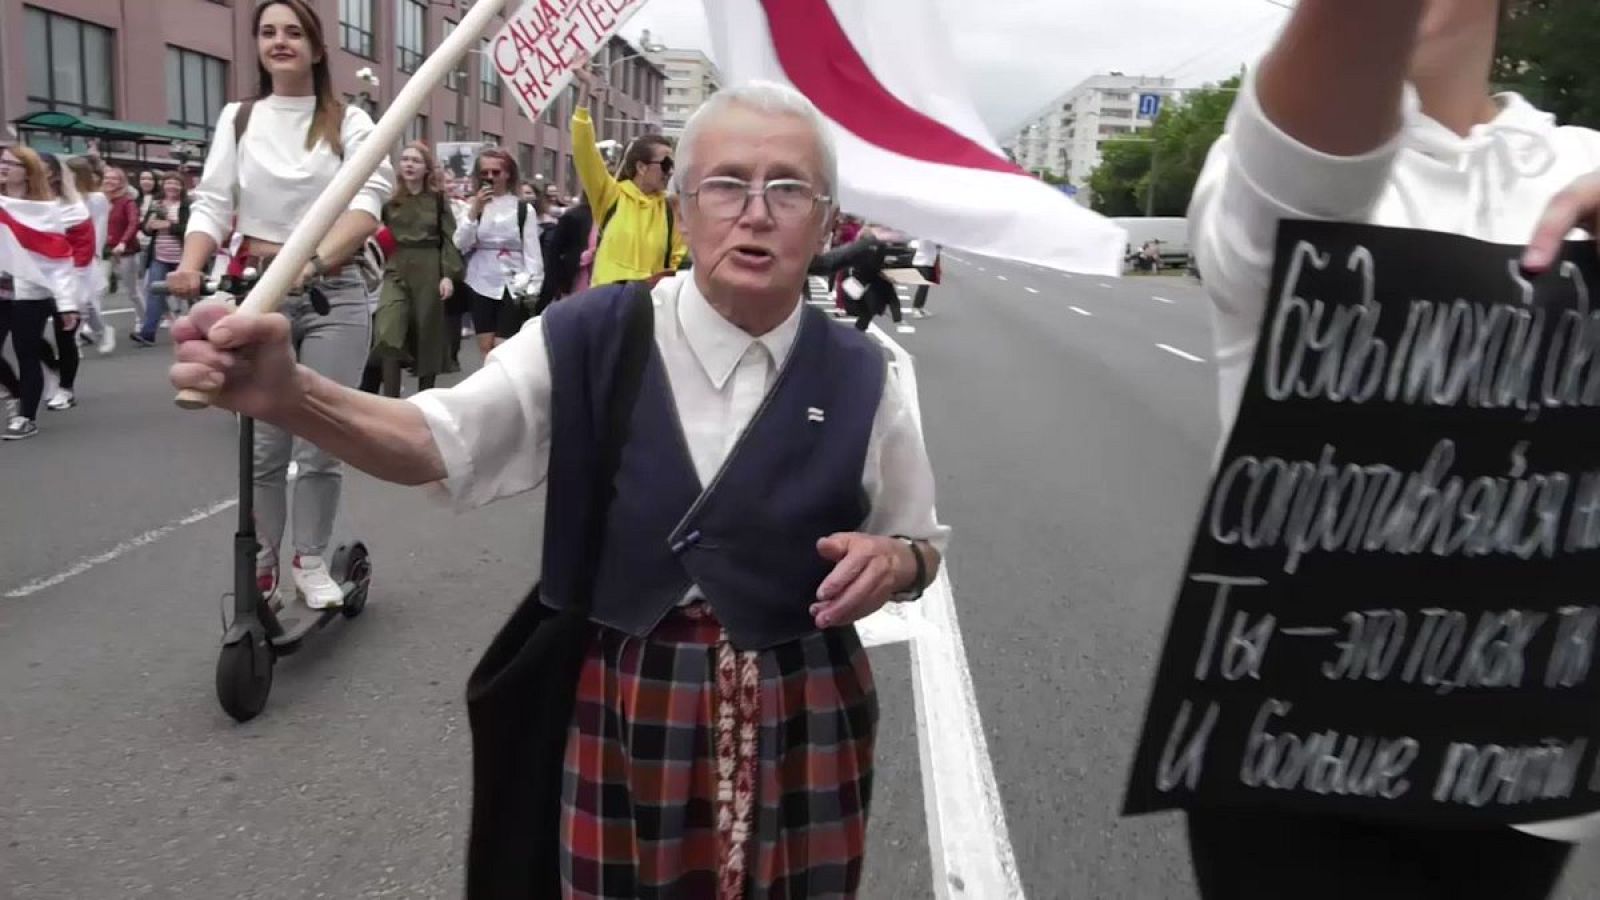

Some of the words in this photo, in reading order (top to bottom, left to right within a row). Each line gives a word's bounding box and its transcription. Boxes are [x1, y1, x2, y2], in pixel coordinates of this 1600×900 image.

[1265, 239, 1387, 402] Будь
[1189, 572, 1277, 681] Ты
[1321, 607, 1407, 681] это
[1156, 699, 1221, 792] И
[1239, 698, 1420, 799] больше
[1432, 736, 1590, 808] почти
